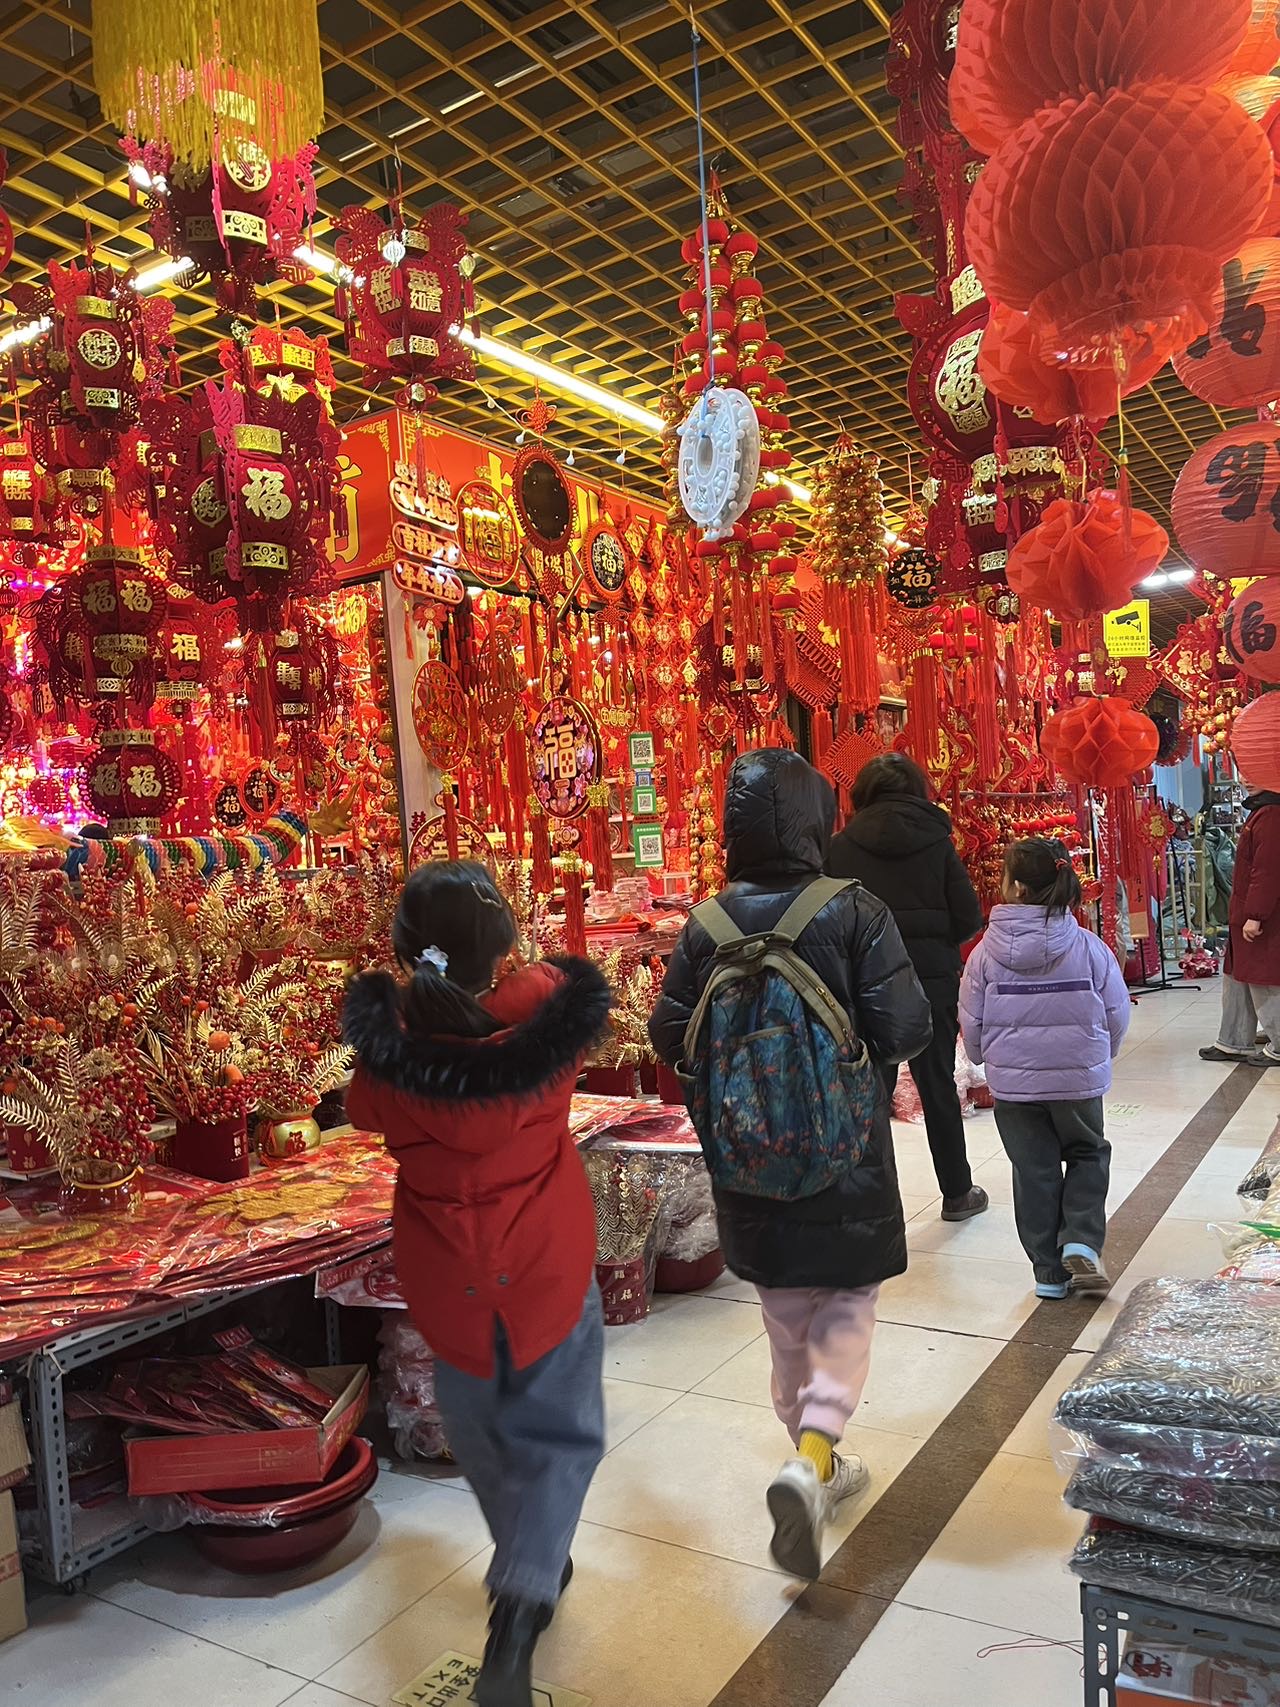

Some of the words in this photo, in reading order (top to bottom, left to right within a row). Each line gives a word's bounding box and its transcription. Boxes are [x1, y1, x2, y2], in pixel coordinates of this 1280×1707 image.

[410, 289, 441, 312] 如意
[241, 467, 292, 521] 福
[901, 562, 931, 588] 福
[83, 579, 117, 615] 福
[120, 579, 153, 613] 福
[170, 632, 200, 662] 福
[544, 723, 578, 781] 福
[126, 764, 162, 798] 福
[223, 795, 240, 814] 福
[412, 1658, 465, 1701] EXIT
[426, 1664, 481, 1707] 安全出口
